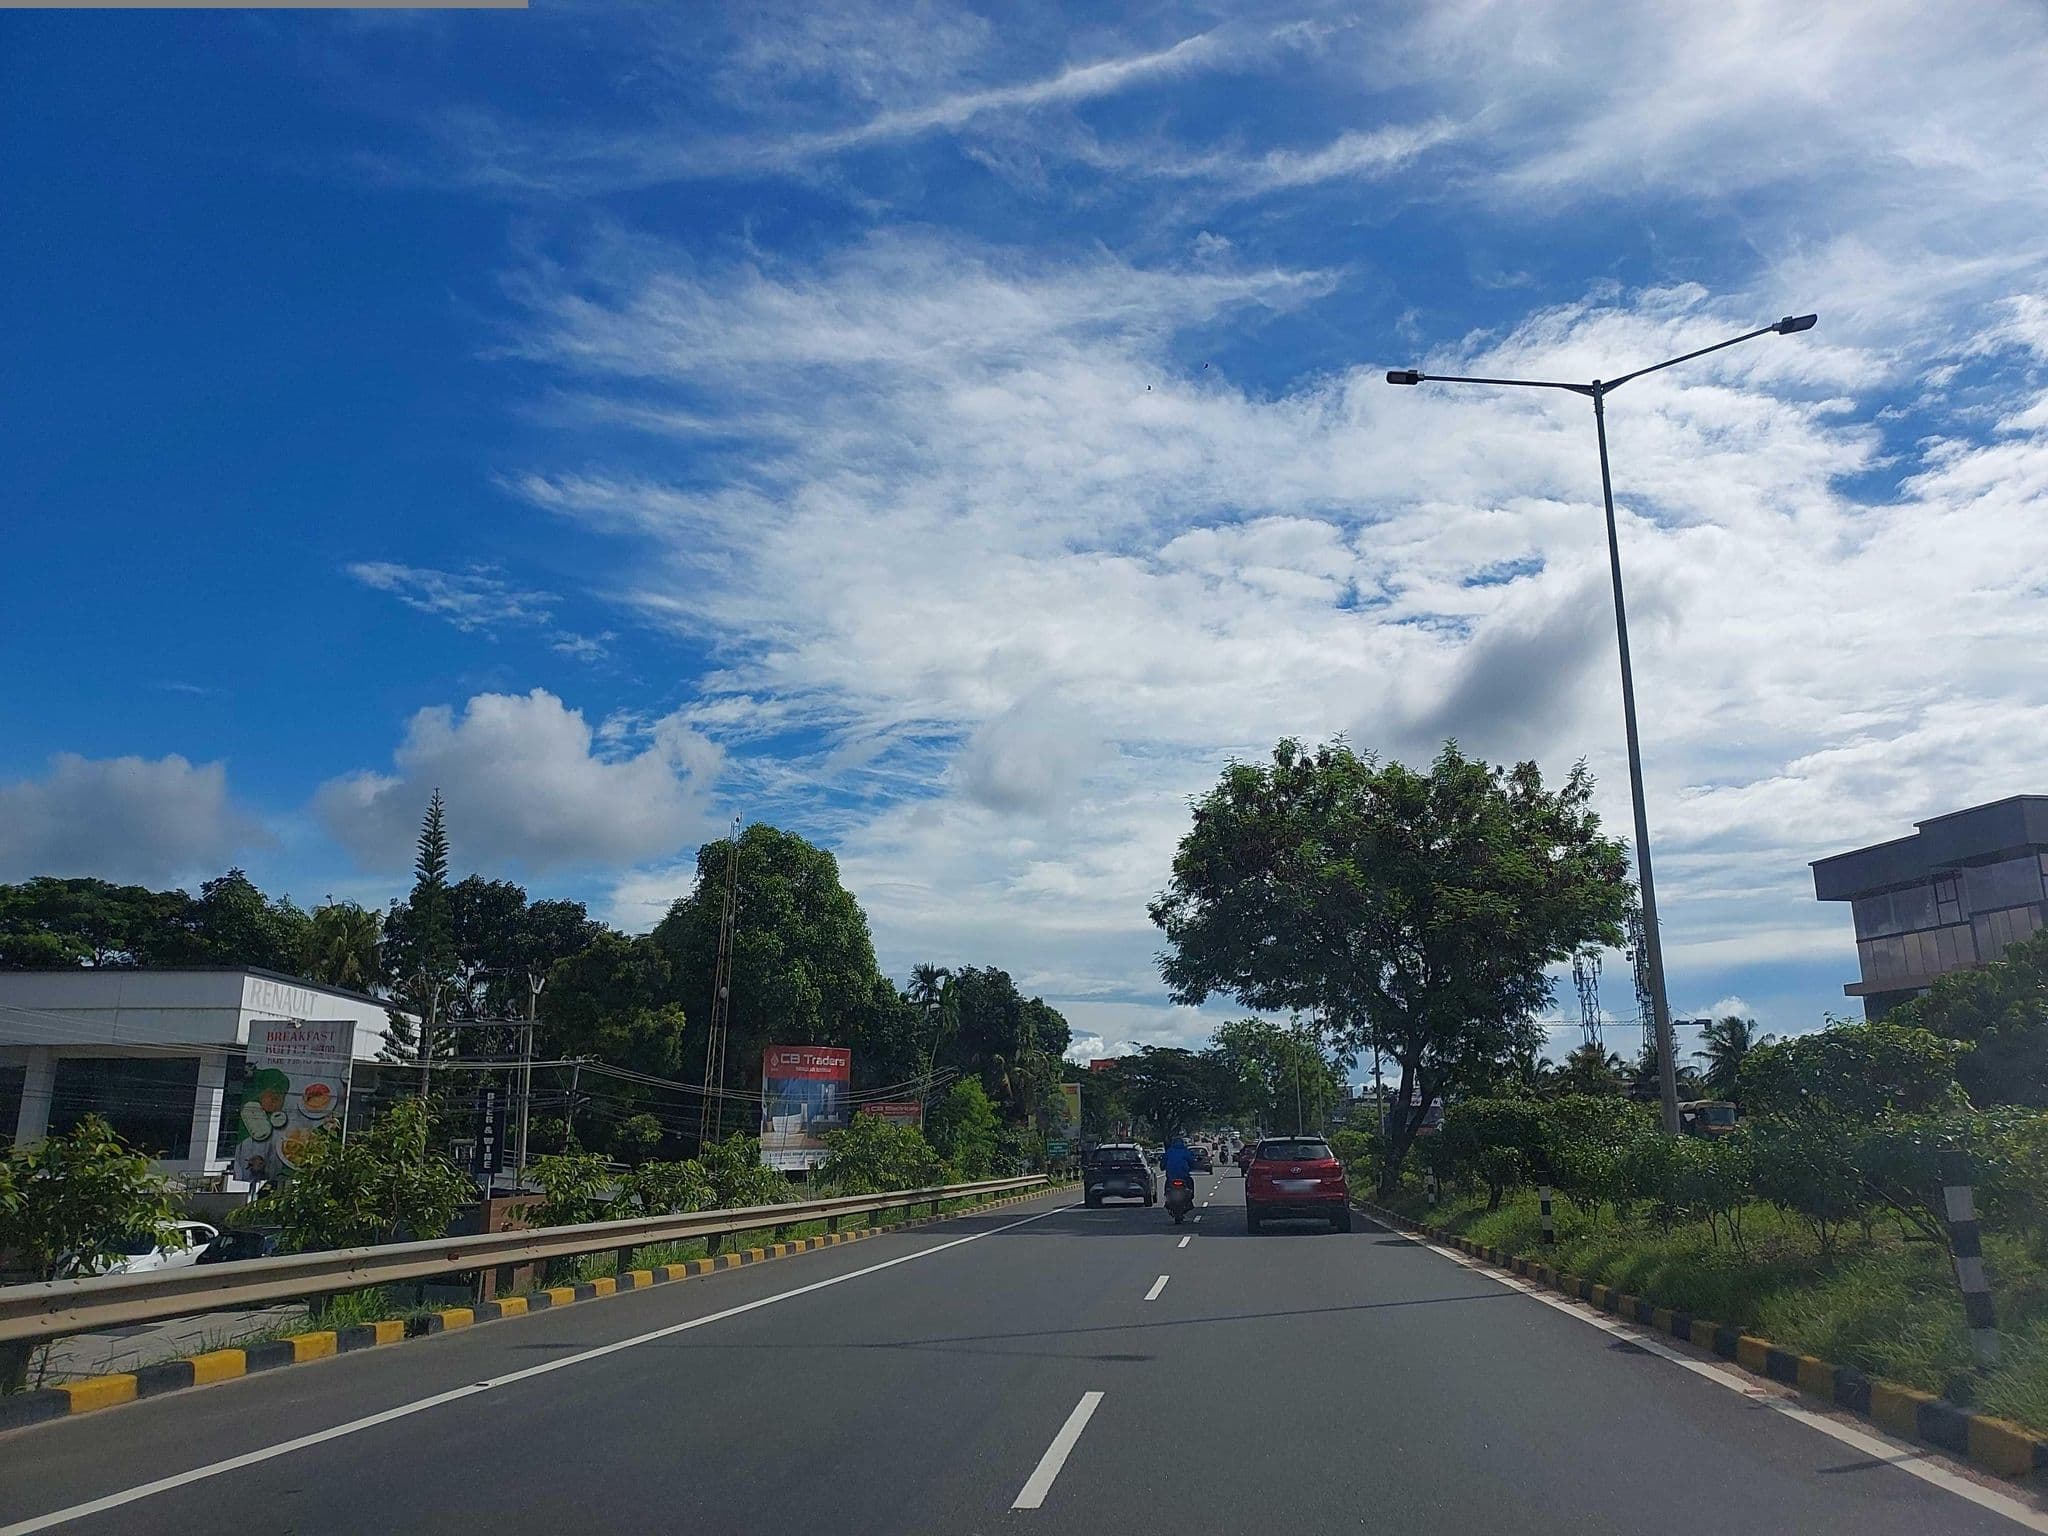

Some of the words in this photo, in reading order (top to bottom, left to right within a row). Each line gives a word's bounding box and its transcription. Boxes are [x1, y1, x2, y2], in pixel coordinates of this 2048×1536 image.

[249, 980, 318, 1017] RENAULT
[266, 1031, 336, 1041] BREAKFAST
[780, 1053, 800, 1064] CB
[803, 1054, 846, 1067] Traders
[486, 1092, 495, 1124] BEER
[484, 1126, 493, 1134] &
[483, 1137, 494, 1169] WINE
